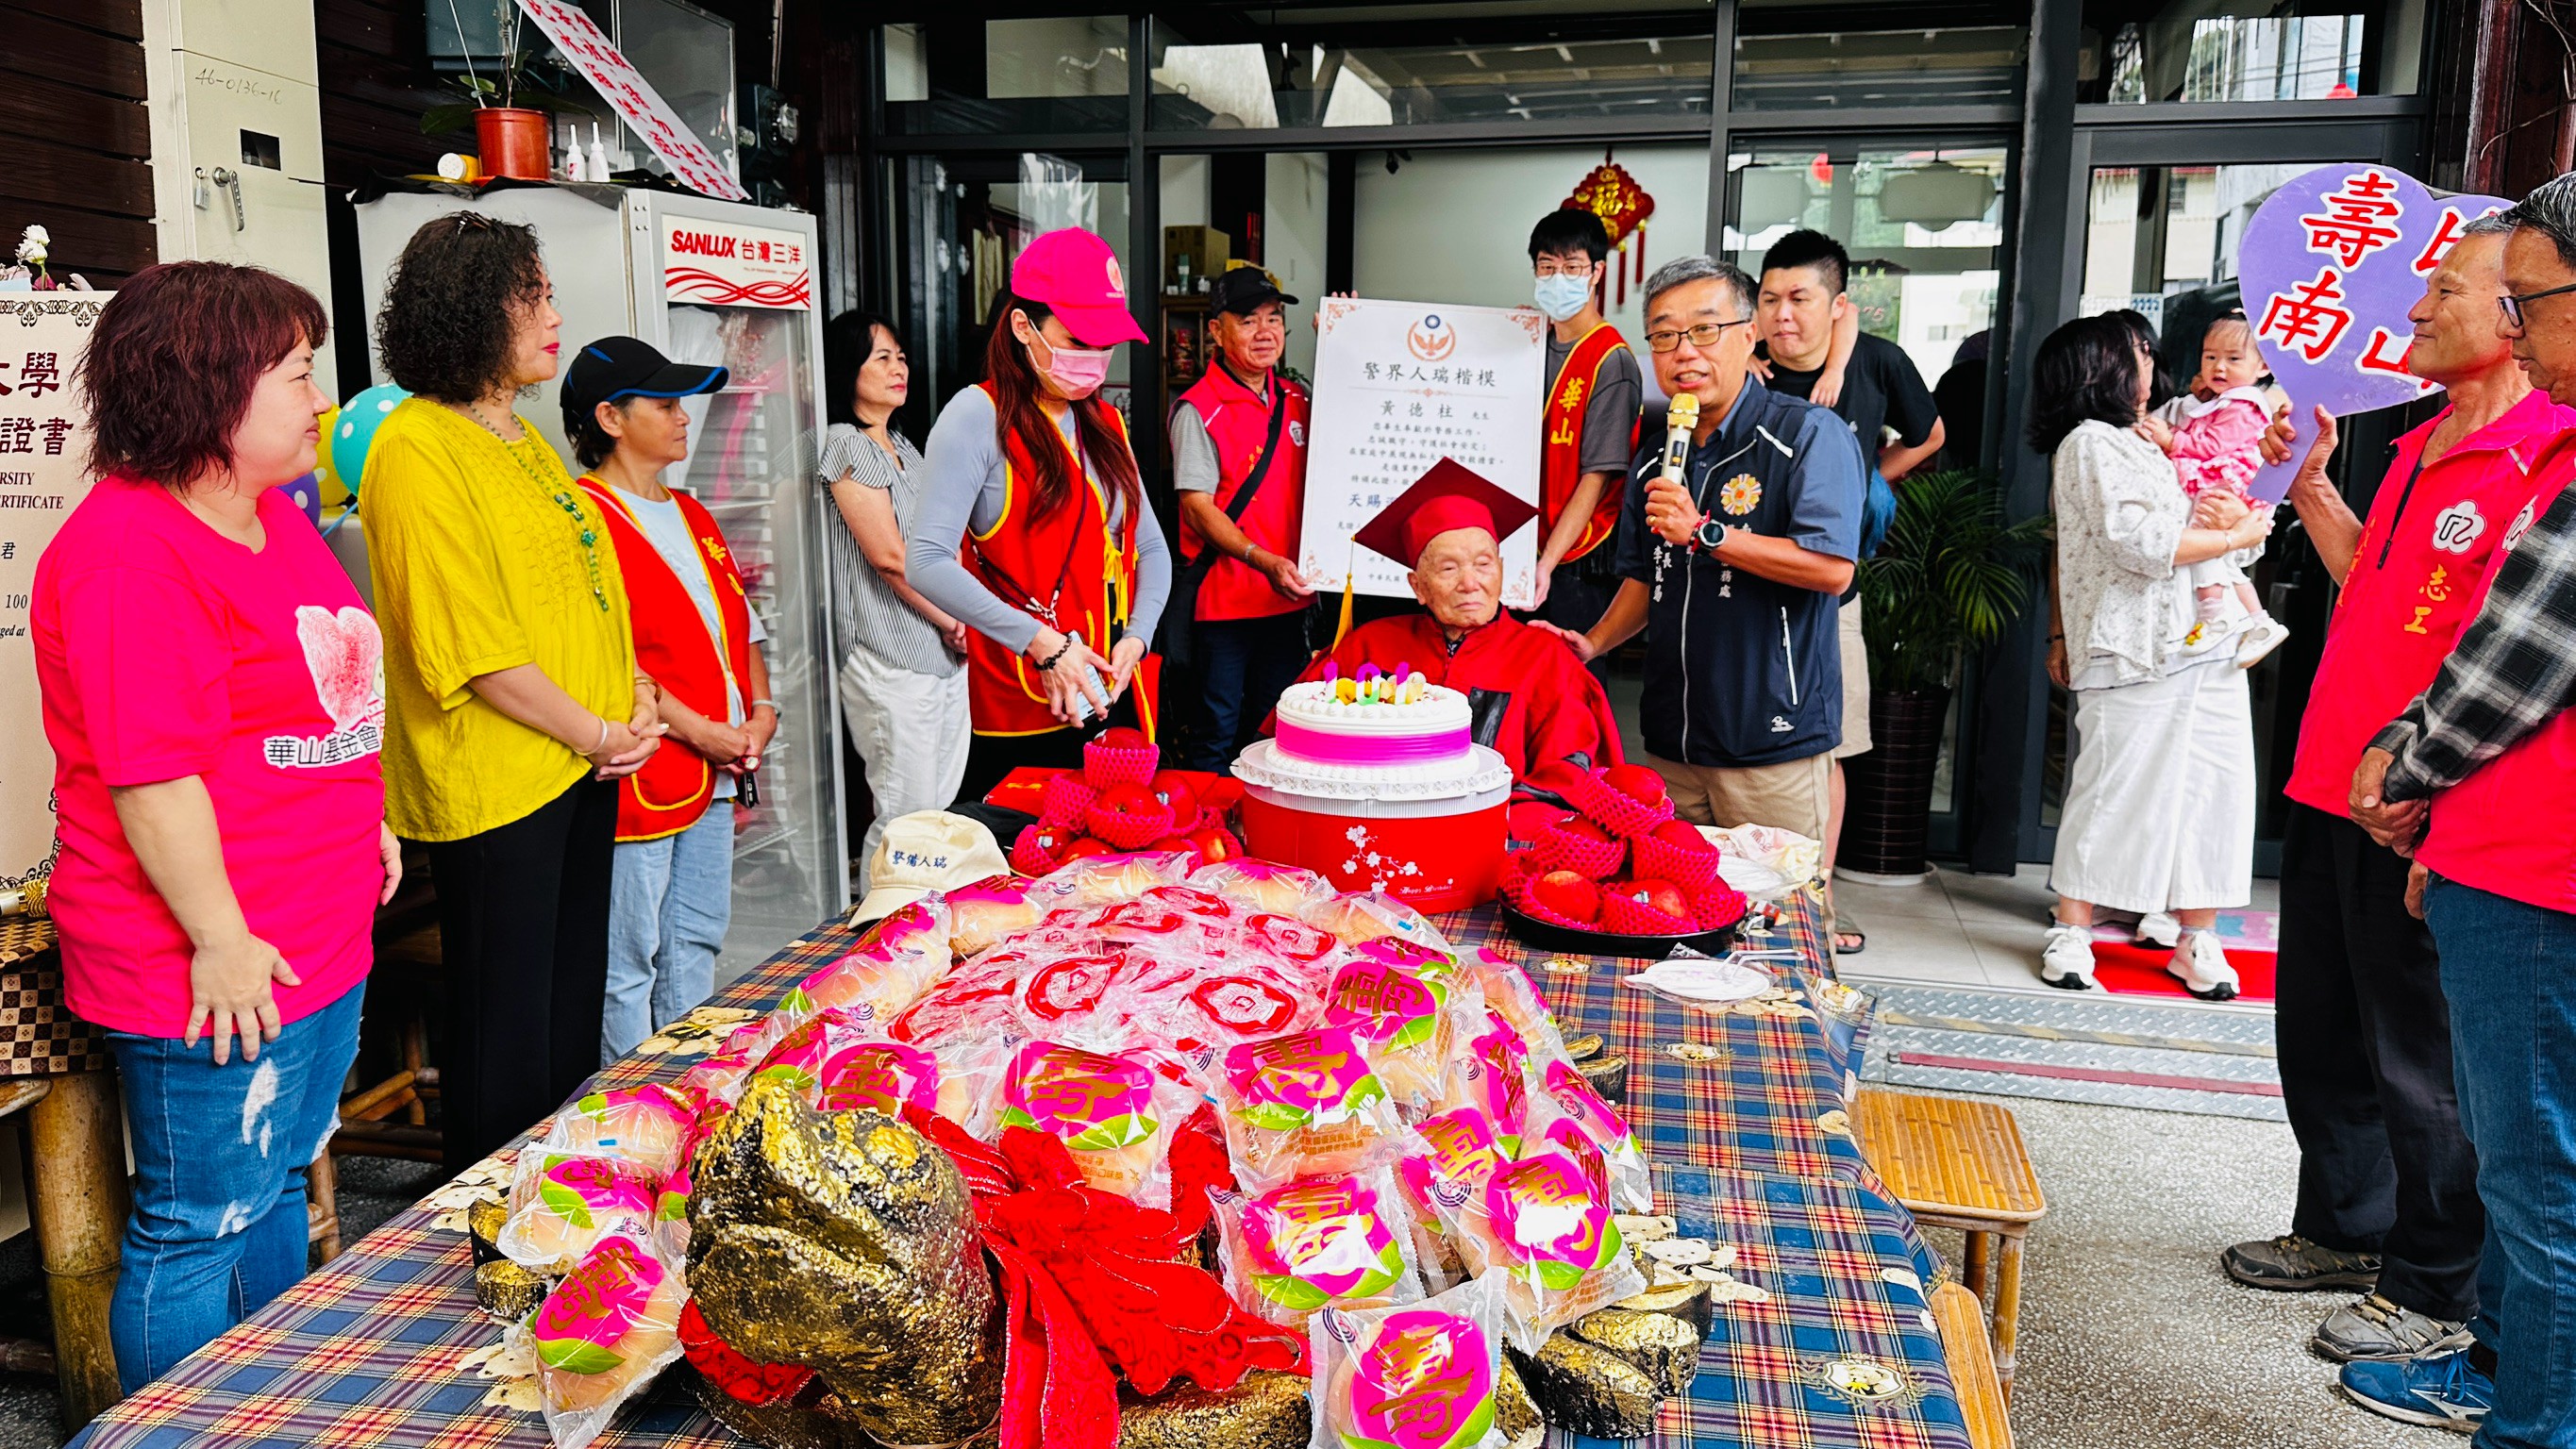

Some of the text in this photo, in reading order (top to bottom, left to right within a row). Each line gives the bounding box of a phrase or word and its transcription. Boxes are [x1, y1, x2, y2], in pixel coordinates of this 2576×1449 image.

[671, 229, 801, 265] SANLUX 台灣三洋
[1363, 361, 1497, 388] 警界人瑞楷模
[1380, 399, 1454, 419] 黃德柱
[1549, 376, 1586, 447] 華山
[1, 541, 16, 559] 君
[6, 594, 28, 609] 100
[2403, 563, 2451, 635] 志工
[16, 626, 25, 637] at
[266, 724, 380, 765] 華山基金會
[1014, 1047, 1130, 1122] 壽
[1367, 1325, 1475, 1440] 壽
